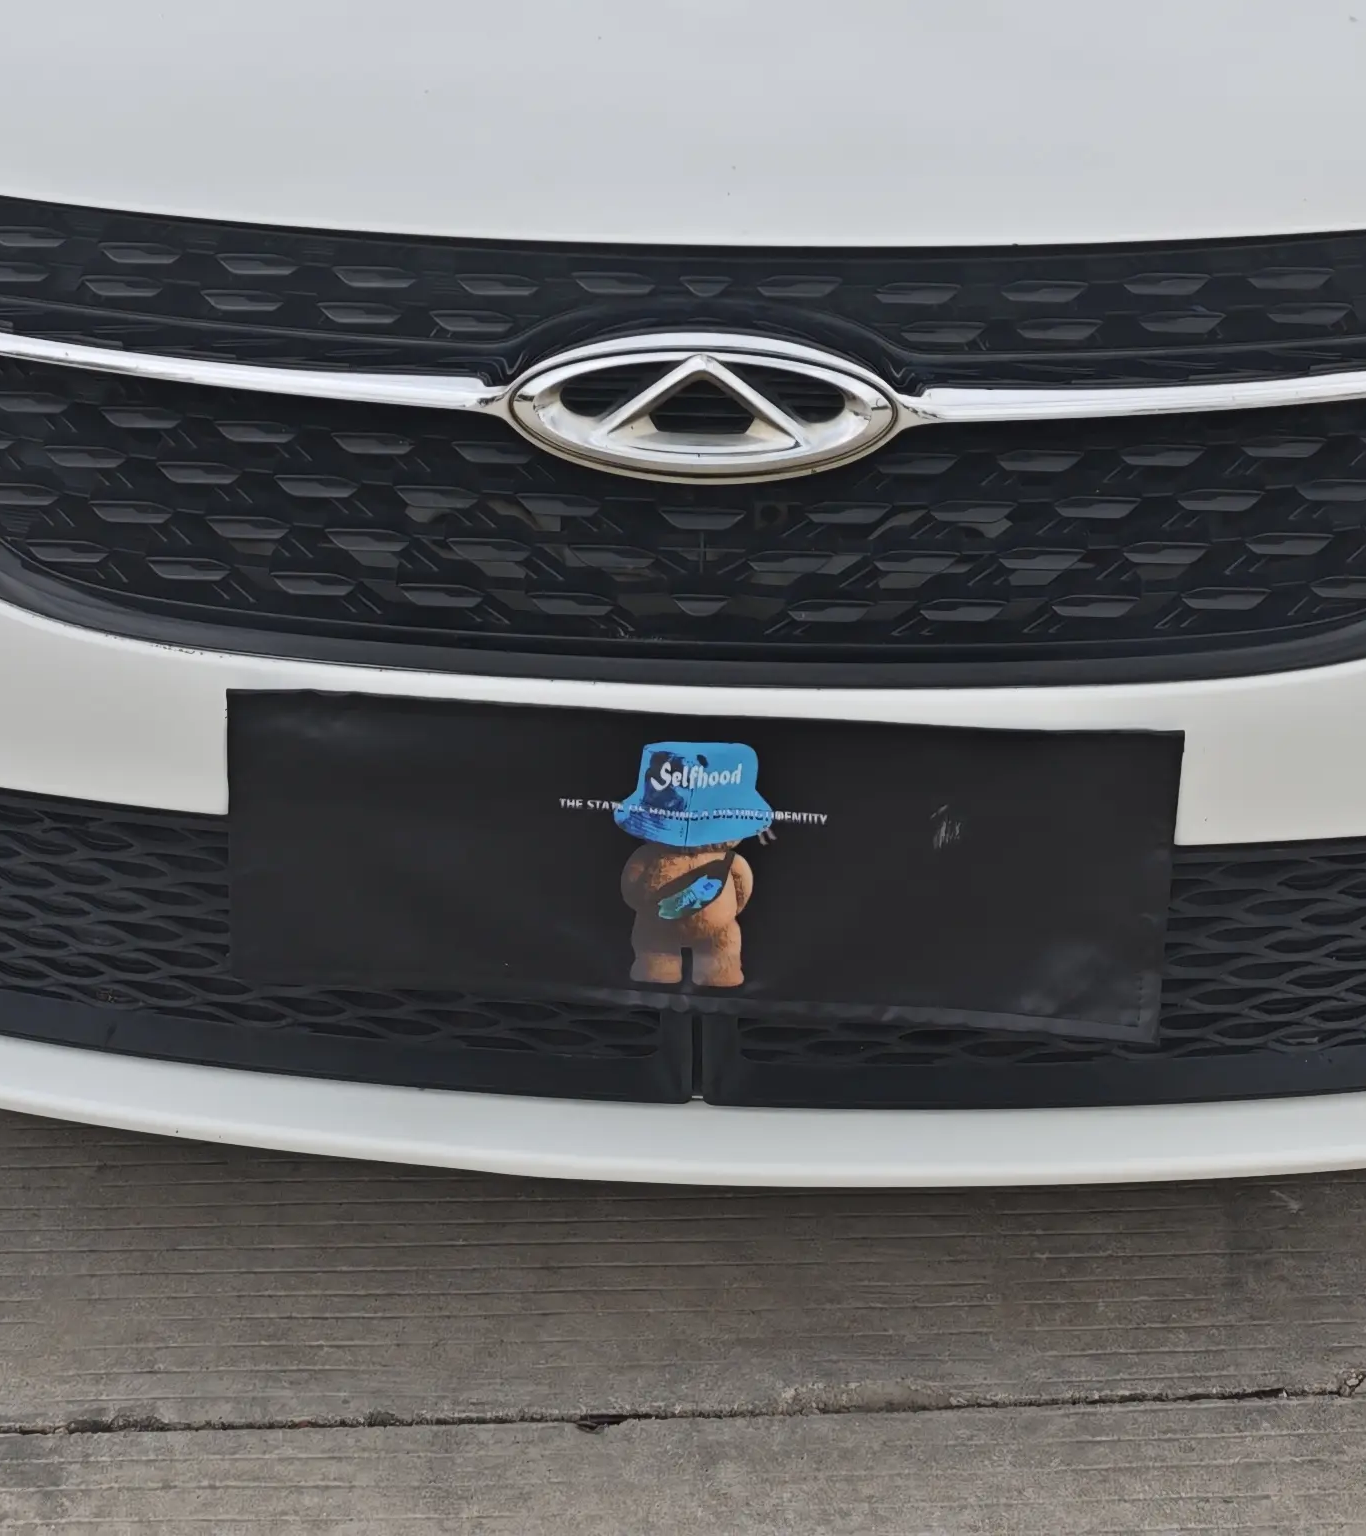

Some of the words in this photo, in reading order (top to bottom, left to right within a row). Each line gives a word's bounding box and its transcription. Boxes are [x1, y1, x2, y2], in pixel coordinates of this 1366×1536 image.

[650, 761, 743, 791] Selfhood
[558, 797, 583, 810] THE
[586, 799, 624, 813] STATE
